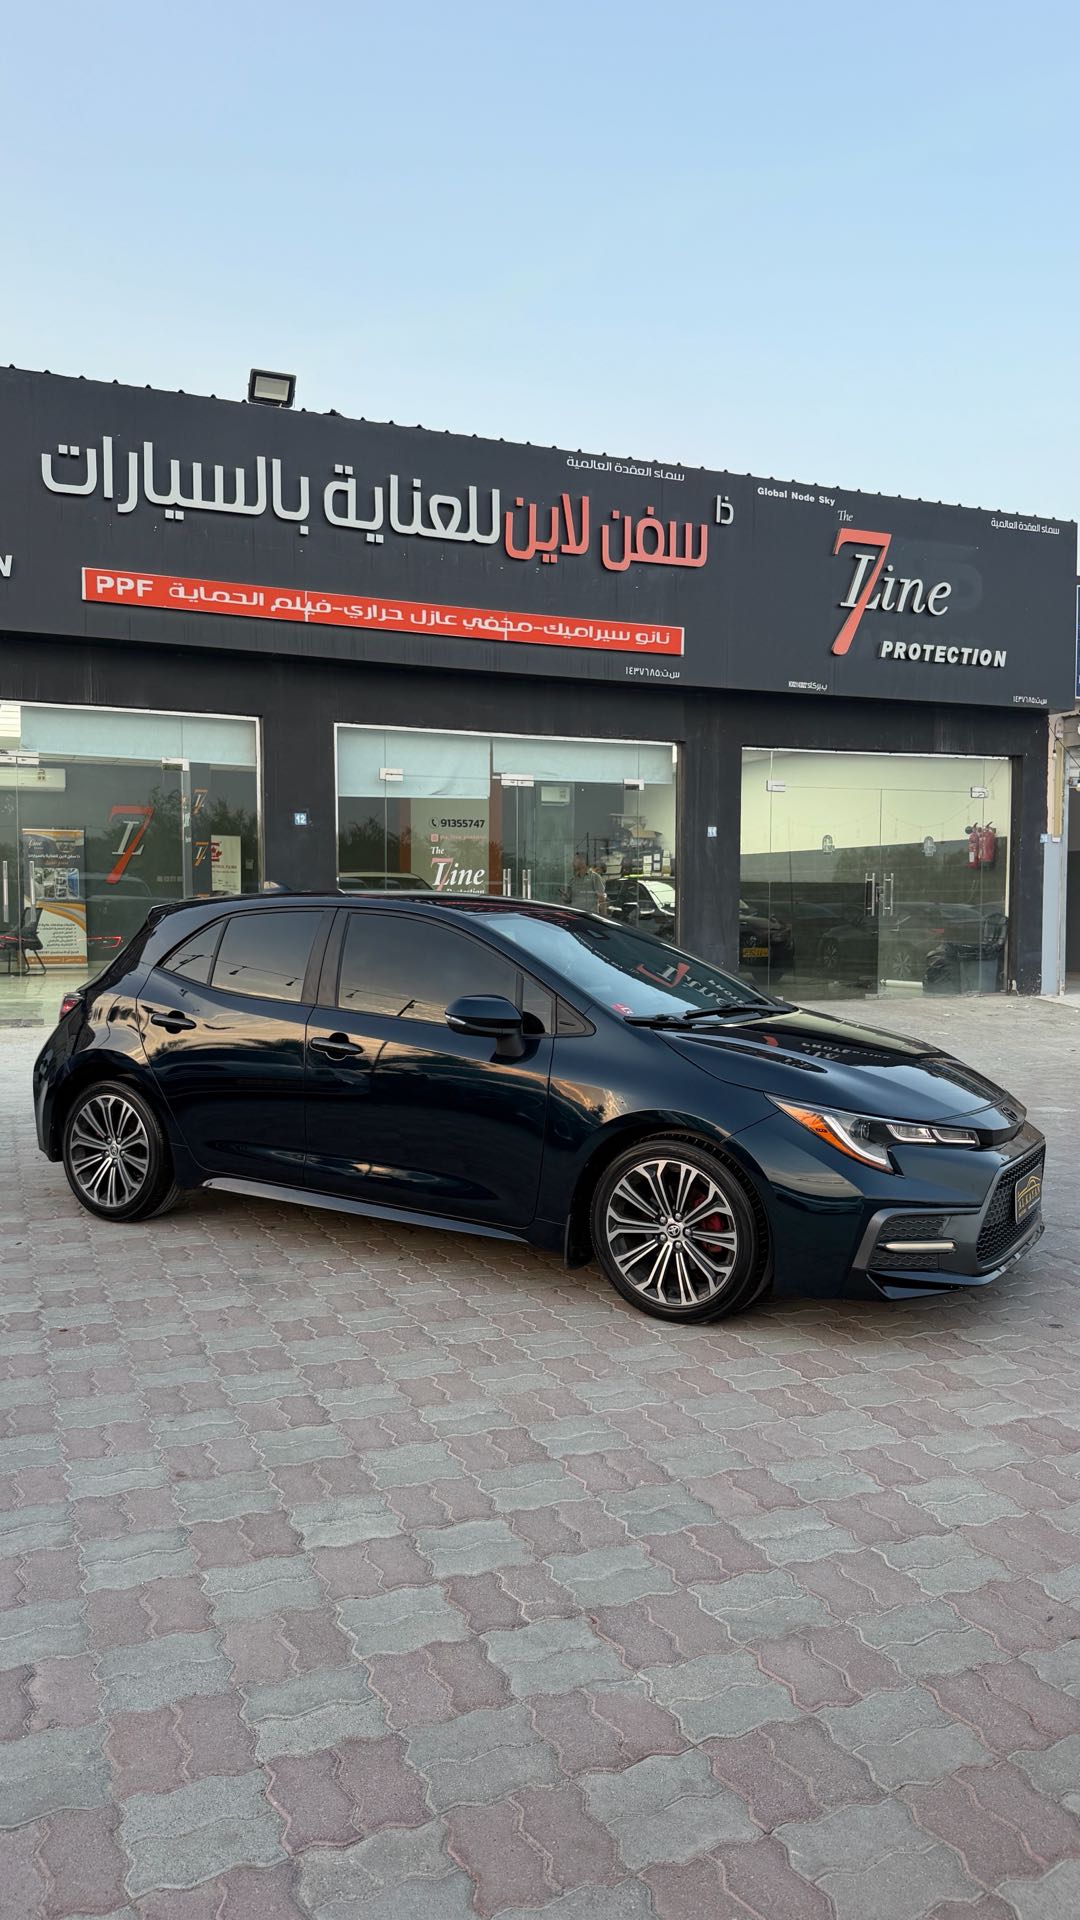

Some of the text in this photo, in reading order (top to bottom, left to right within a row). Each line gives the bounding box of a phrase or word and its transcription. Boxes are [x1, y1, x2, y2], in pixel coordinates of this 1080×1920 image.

[566, 456, 685, 482] سماء العقدة العالمية
[41, 435, 310, 536] بالسيارات
[757, 486, 836, 507] Global Node Sky
[323, 463, 500, 544] للعناية
[837, 509, 854, 522] The
[505, 493, 590, 564] لاين
[601, 505, 709, 572] سفن
[96, 575, 154, 598] PPF
[168, 582, 265, 607] الحماية
[839, 553, 952, 616] Line
[410, 609, 458, 627] عازل
[635, 631, 670, 645] نانو
[880, 640, 1007, 668] PROTECTION
[440, 818, 486, 829] 91355747
[431, 846, 445, 855] The
[432, 862, 486, 886] Line
